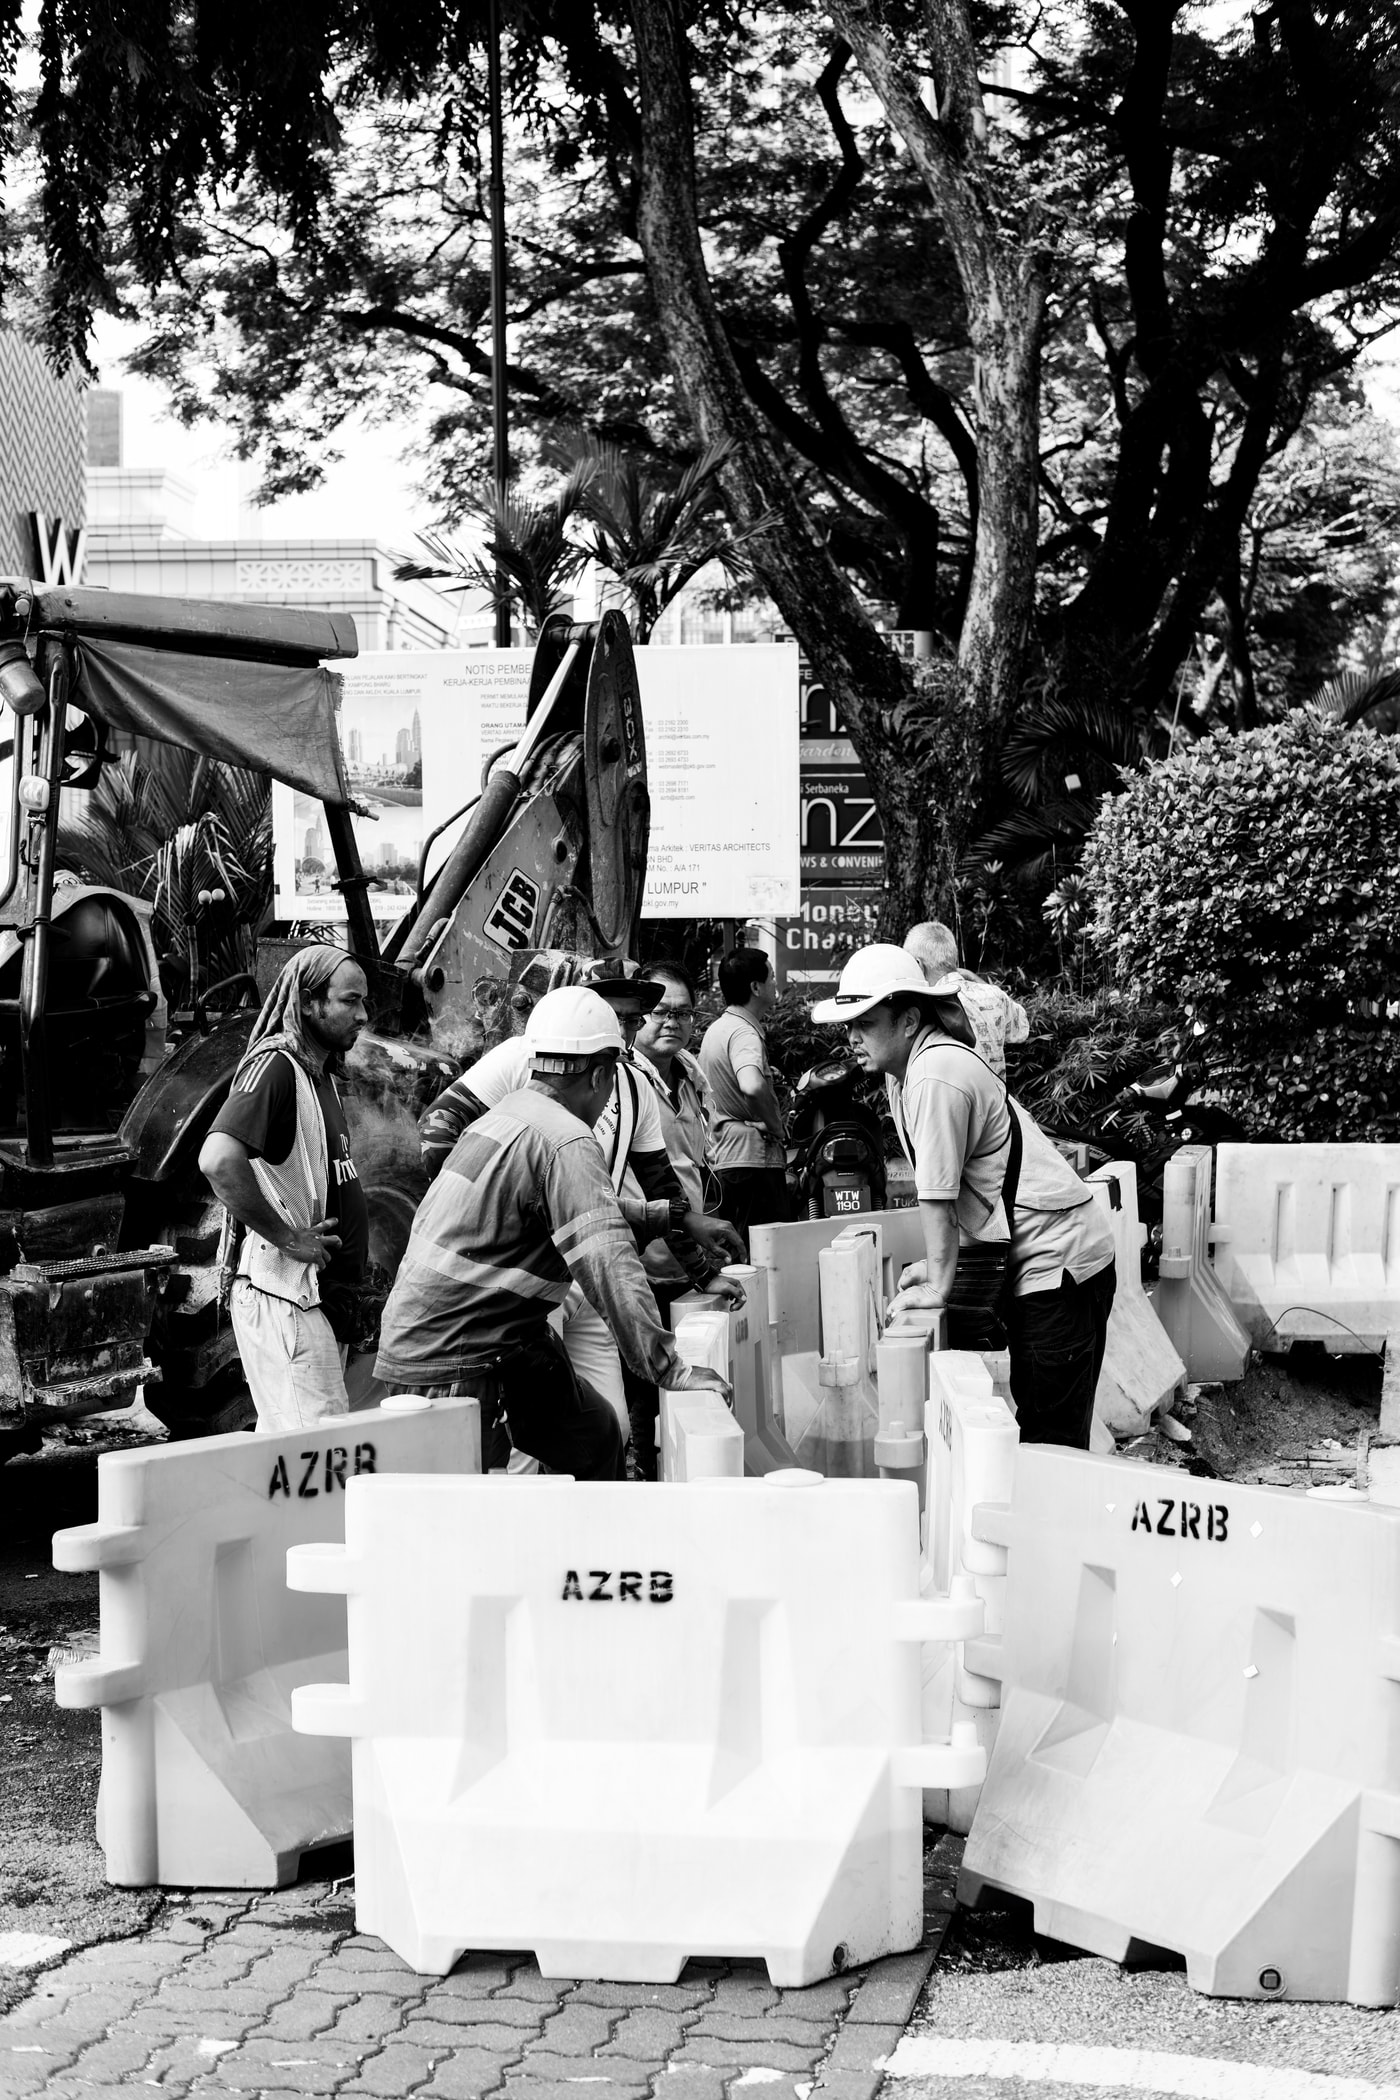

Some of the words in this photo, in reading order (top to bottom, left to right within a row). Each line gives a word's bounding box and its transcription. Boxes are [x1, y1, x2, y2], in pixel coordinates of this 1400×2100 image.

[29, 511, 87, 586] W
[465, 664, 495, 675] NOTIS
[497, 663, 531, 675] PEMBE
[442, 678, 493, 686] KERJA-KERJA
[804, 782, 850, 794] Serbaneka
[689, 843, 721, 852] VERITAS
[722, 842, 771, 851] ARCHITECTS
[657, 855, 674, 863] BHD
[800, 856, 817, 868] WS
[819, 856, 828, 868] &
[688, 863, 701, 872] 171
[646, 881, 700, 895] LUMPUR
[490, 874, 537, 950] JCB
[835, 1190, 860, 1201] WTW
[836, 1200, 860, 1211] 1190
[268, 1442, 378, 1499] AZRB
[1131, 1498, 1229, 1542] AZRB
[561, 1570, 674, 1604] AZRB
